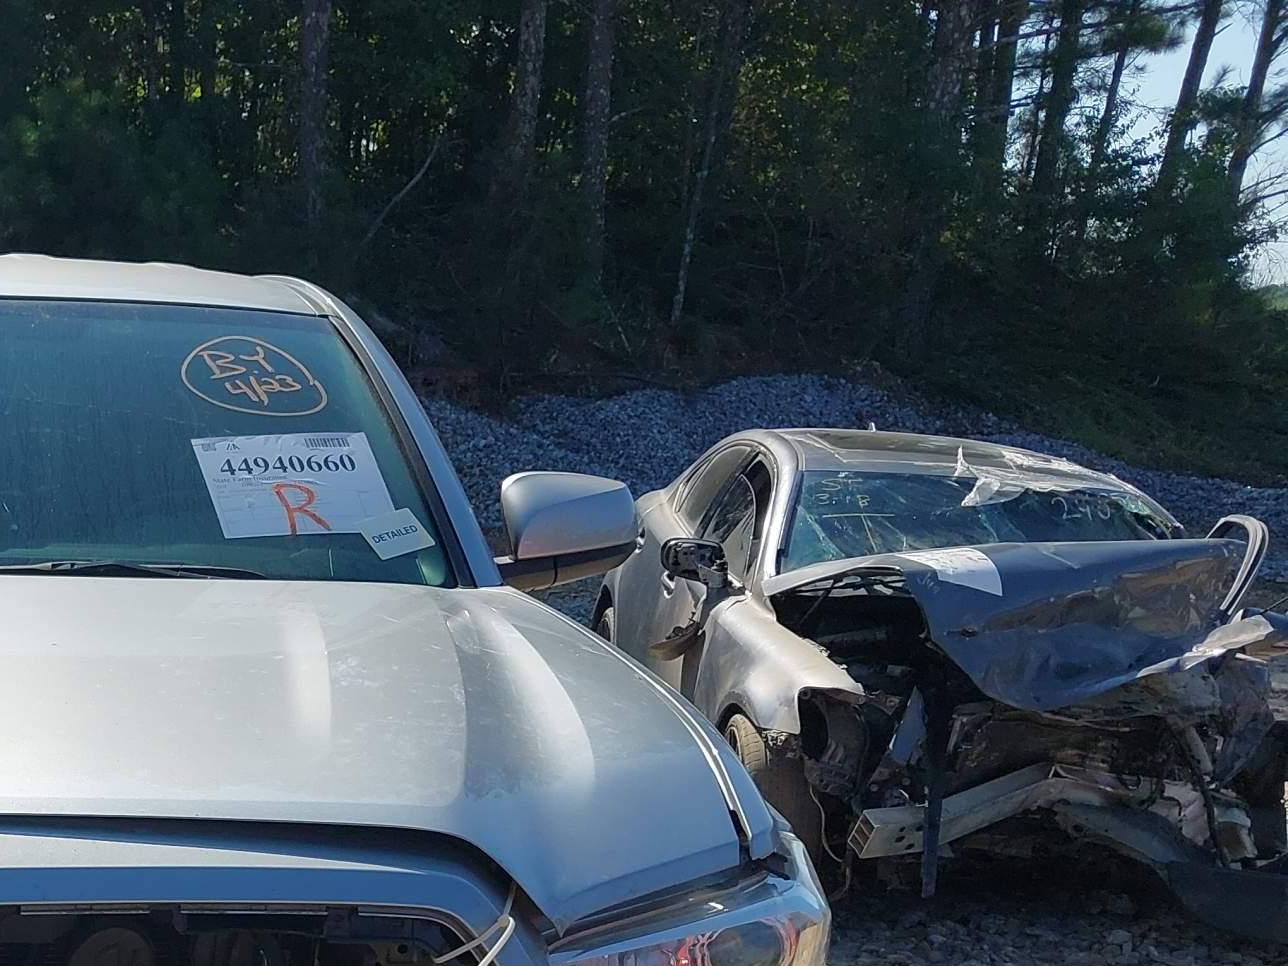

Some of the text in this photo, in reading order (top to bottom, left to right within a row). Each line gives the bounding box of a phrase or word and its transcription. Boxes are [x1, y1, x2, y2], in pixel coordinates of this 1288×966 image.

[220, 454, 356, 476] 44940660
[273, 484, 332, 536] R
[372, 525, 418, 544] DETAILED
